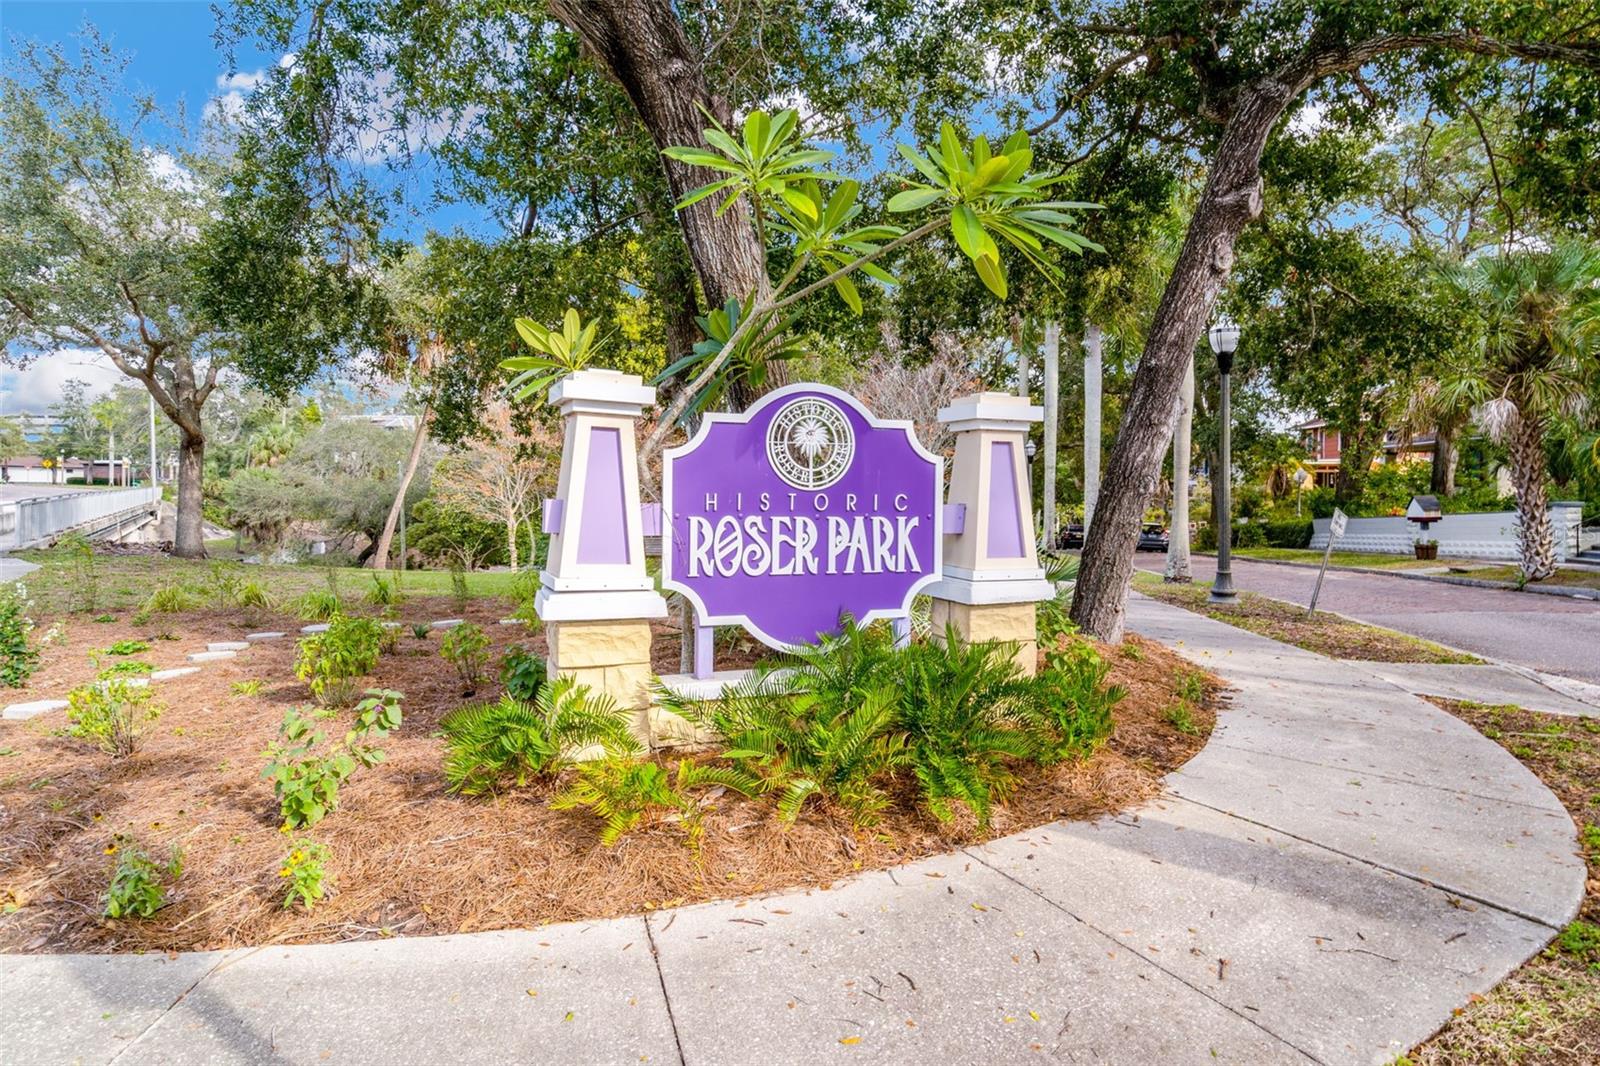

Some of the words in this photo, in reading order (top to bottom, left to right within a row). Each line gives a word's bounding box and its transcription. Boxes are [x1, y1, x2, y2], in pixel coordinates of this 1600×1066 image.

[774, 443, 810, 482] ROSER
[705, 493, 908, 511] HISTORIC
[687, 515, 819, 577] ROSER
[826, 516, 922, 574] PARK
